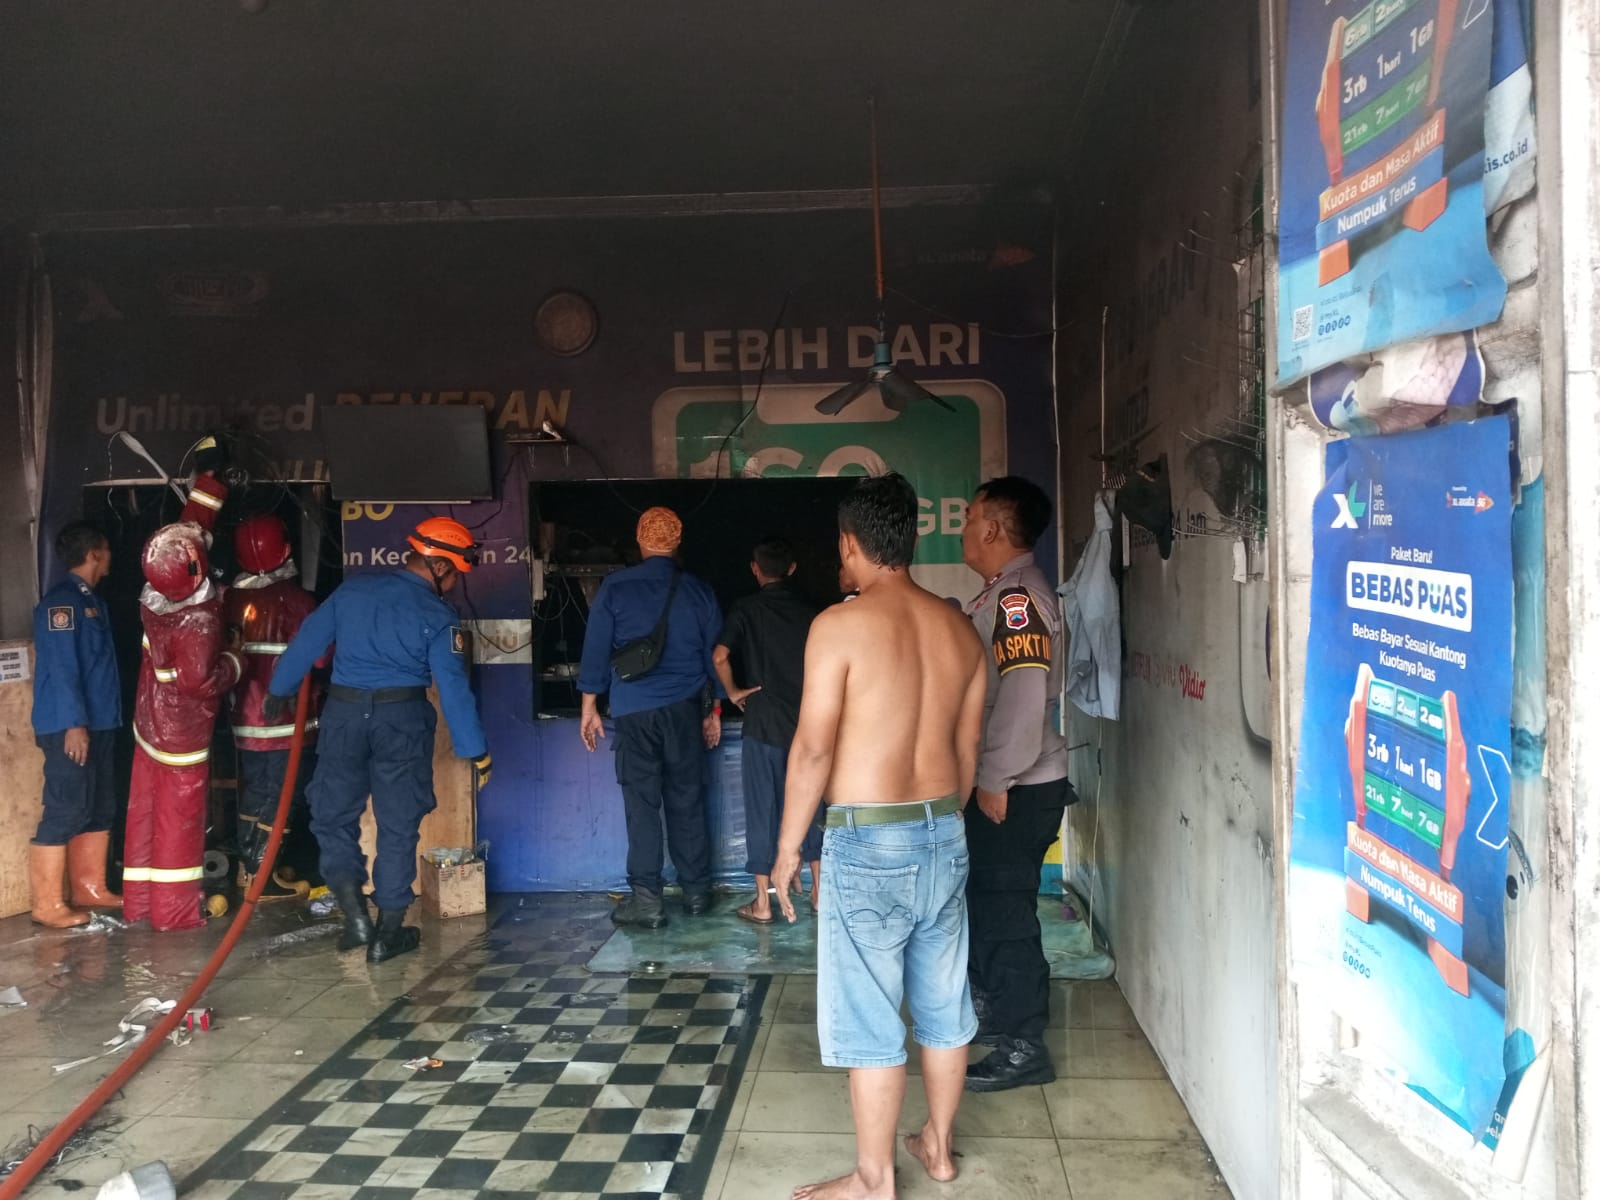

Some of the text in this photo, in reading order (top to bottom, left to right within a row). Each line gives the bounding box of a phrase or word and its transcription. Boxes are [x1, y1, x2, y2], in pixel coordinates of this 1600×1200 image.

[1343, 74, 1367, 104] 3rb
[1410, 19, 1434, 54] 1GB
[1323, 118, 1440, 213] Kuota dan Masa Aktif
[1484, 137, 1528, 174] is.co.id
[1337, 175, 1417, 235] Numpuk Terus
[673, 321, 981, 373] LEBIH DARI
[97, 391, 316, 436] Unlimted
[916, 497, 969, 536] GB
[1372, 514, 1393, 526] more
[1373, 499, 1385, 511] are
[1391, 546, 1433, 564] Paket Baru!
[1351, 571, 1413, 608] BEBAS
[1006, 633, 1041, 660] SPKT
[1352, 622, 1467, 670] Bebas Bayar Sesuai Kantong
[1379, 650, 1436, 682] Kuotanya Puas
[1420, 706, 1443, 730] 2GB
[1367, 733, 1389, 763] 3rb
[1419, 758, 1442, 791] 1GB
[1366, 785, 1385, 805] 21rb
[1350, 829, 1457, 913] Kuota dan Masa Aktif
[1360, 864, 1436, 932] Numpuk Terus
